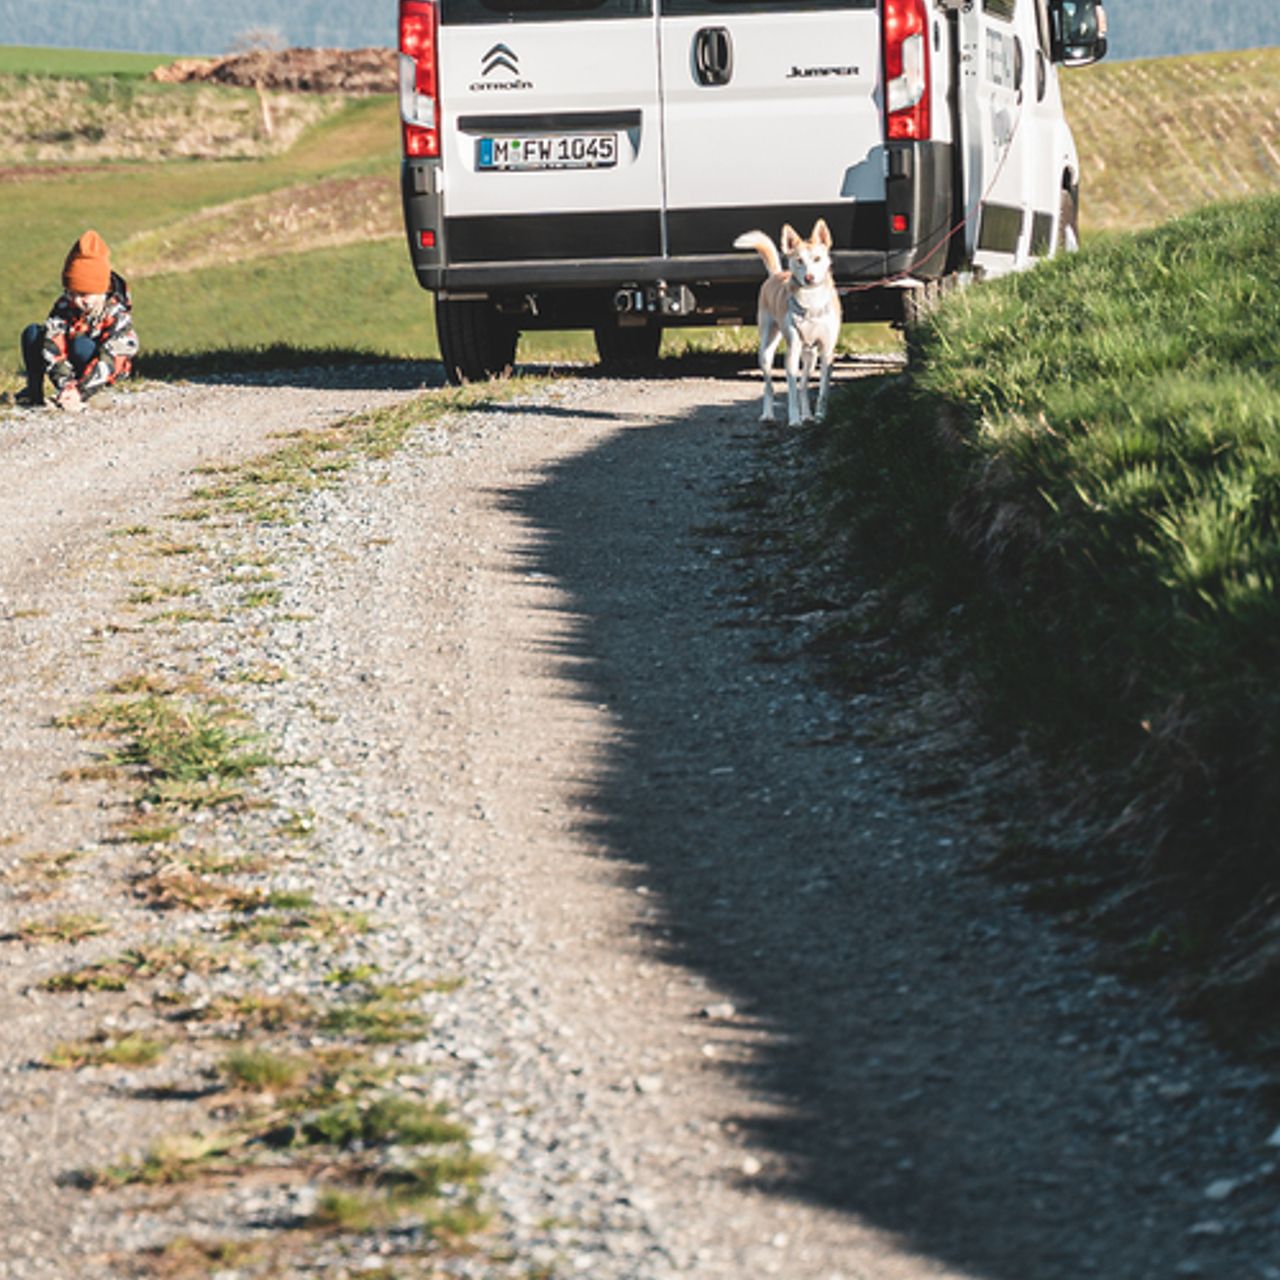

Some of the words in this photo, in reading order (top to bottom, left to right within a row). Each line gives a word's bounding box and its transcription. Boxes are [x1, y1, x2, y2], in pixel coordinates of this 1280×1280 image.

[494, 141, 508, 162] M
[524, 140, 552, 161] FW
[558, 137, 613, 160] 1045
